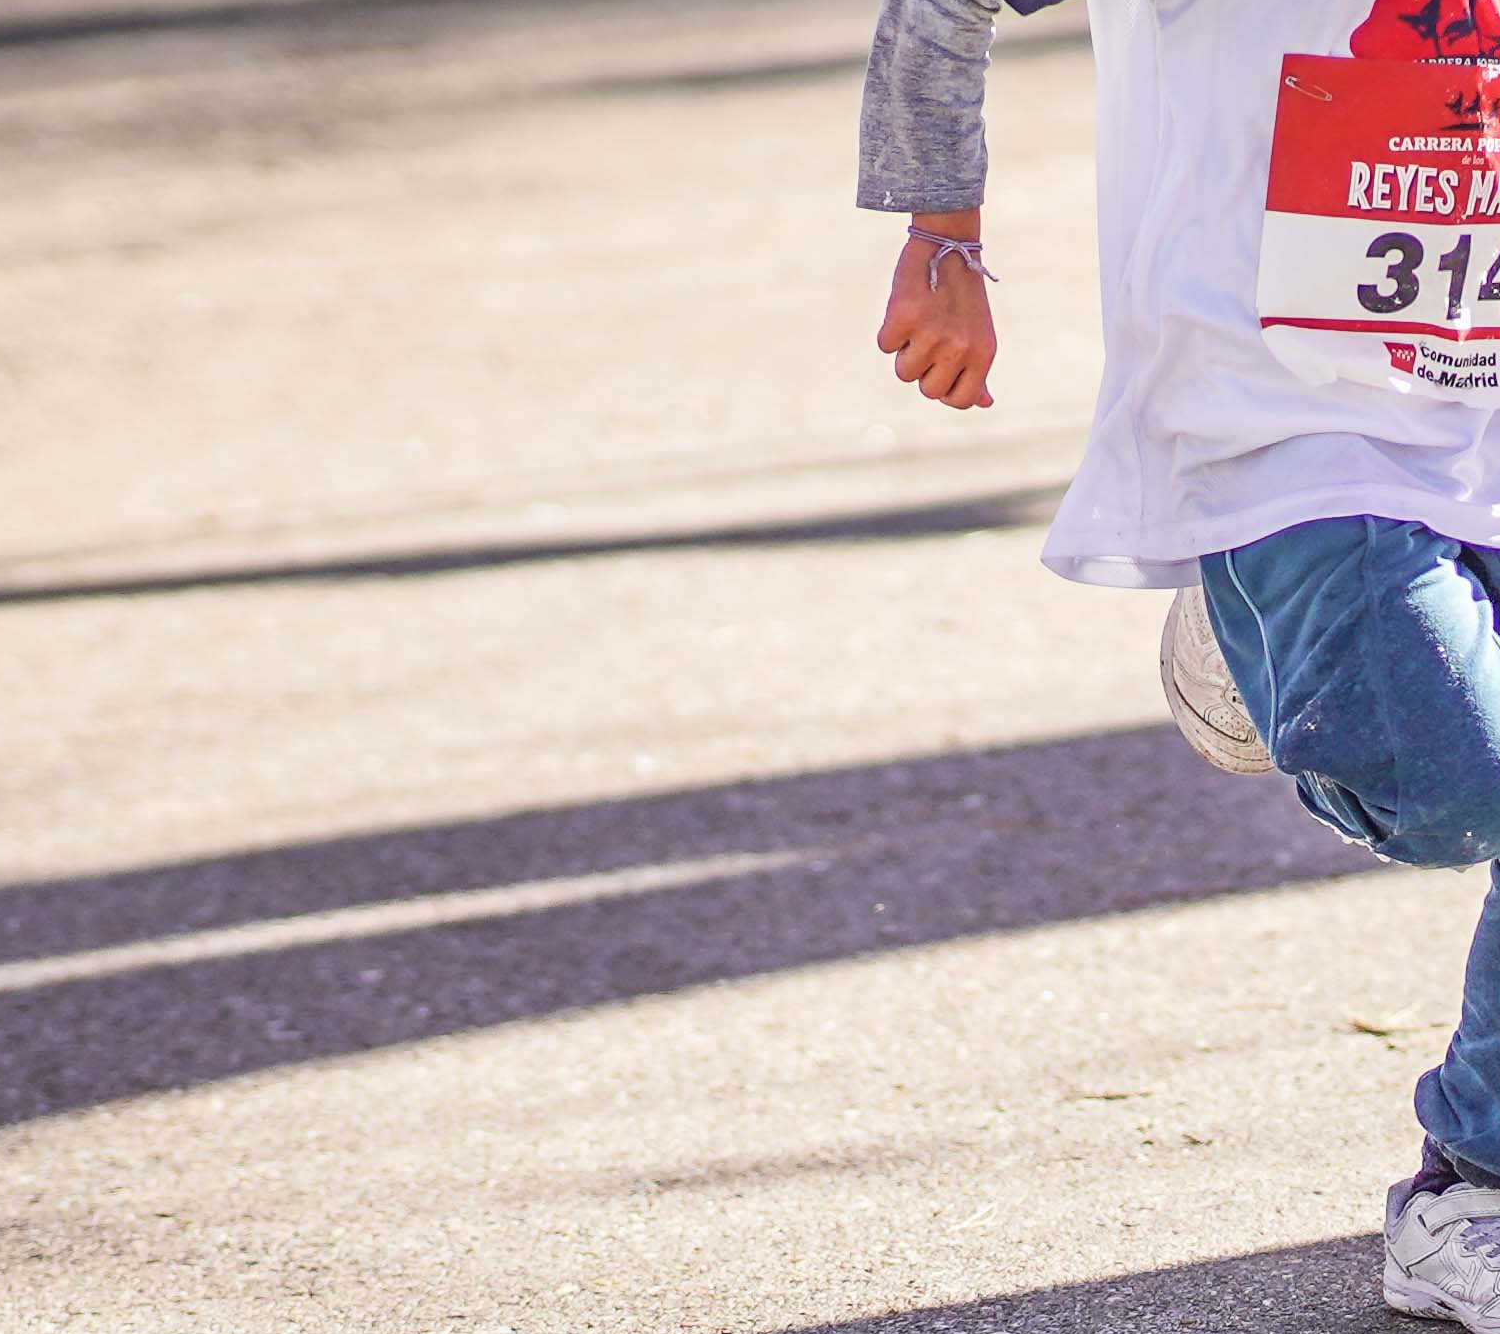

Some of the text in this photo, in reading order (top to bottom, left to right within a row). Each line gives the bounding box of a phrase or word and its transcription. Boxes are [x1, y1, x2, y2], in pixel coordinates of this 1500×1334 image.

[1388, 136, 1473, 152] CARRERA
[1461, 155, 1485, 165] de los
[1347, 161, 1459, 216] REYES
[1419, 342, 1497, 368] Comunidad
[1417, 365, 1499, 389] de Madrid
